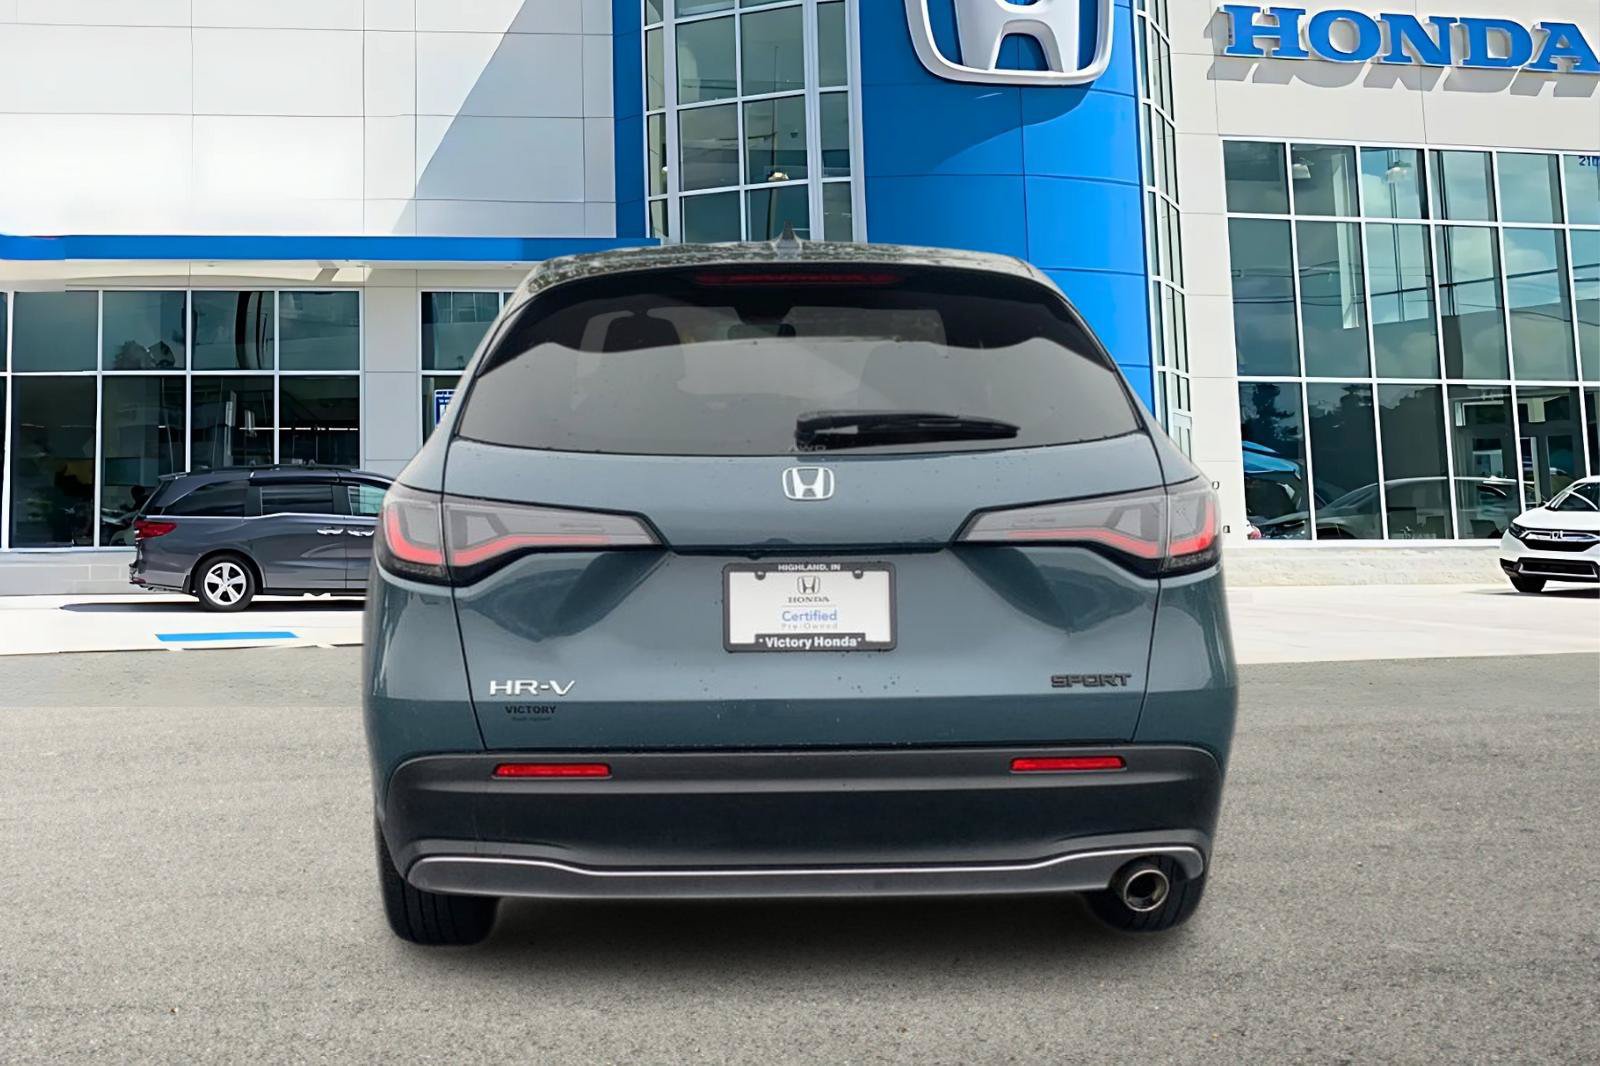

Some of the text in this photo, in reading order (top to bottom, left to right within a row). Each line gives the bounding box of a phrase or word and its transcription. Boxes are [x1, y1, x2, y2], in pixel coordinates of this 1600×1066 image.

[1223, 4, 1600, 73] HONDA
[782, 609, 838, 621] Certified
[765, 635, 857, 650] Victory Honda
[489, 680, 576, 695] HR-V
[1051, 673, 1132, 688] SPORT
[504, 705, 557, 714] VICTORY
